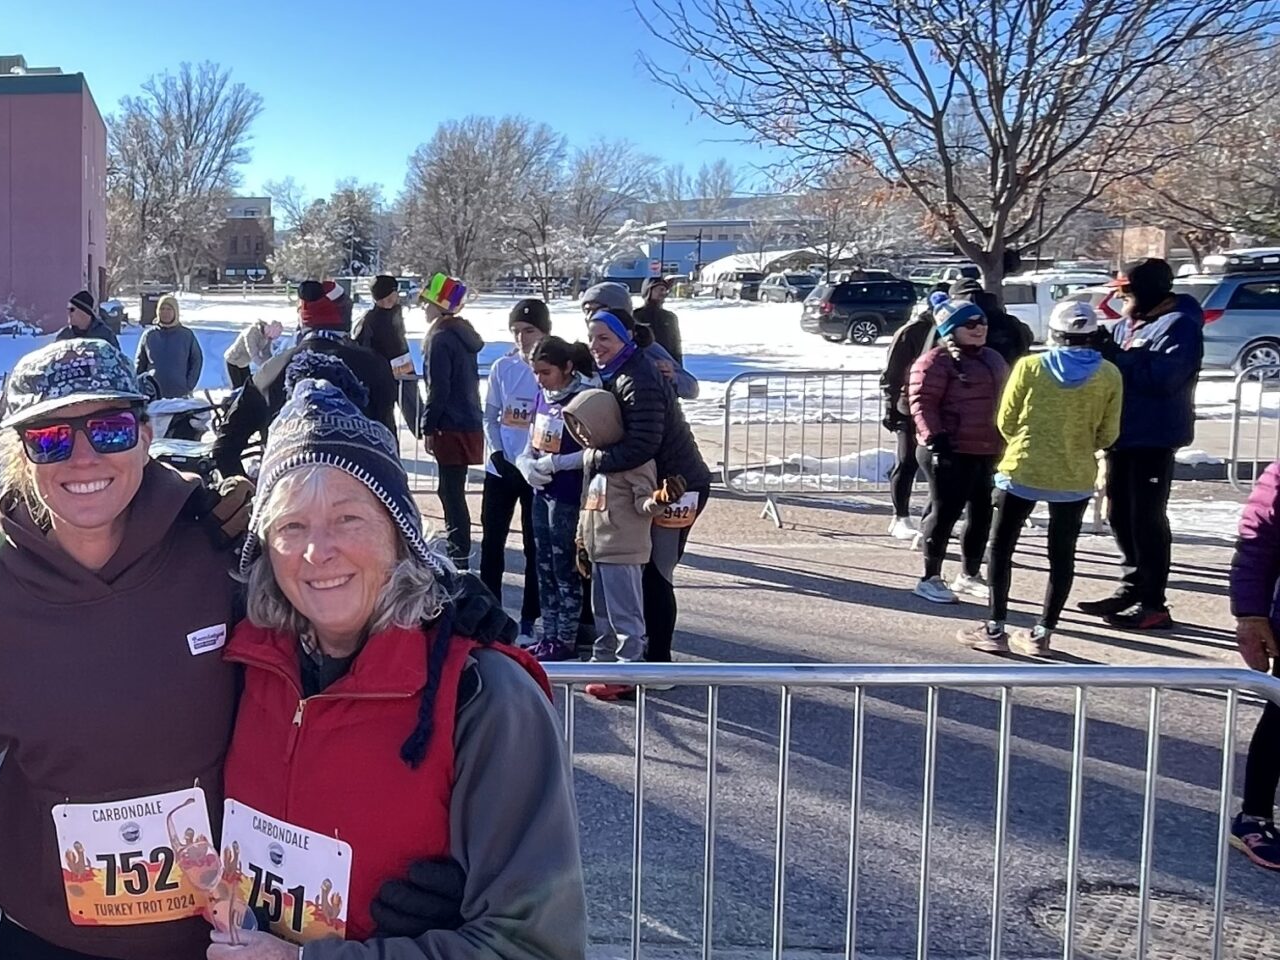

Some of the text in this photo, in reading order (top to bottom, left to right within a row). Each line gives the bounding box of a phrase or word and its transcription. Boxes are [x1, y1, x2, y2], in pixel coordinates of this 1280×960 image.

[664, 505, 689, 519] 942
[92, 801, 163, 822] CARBONDALE
[252, 815, 310, 850] CARBONDALE
[95, 846, 180, 896] 752
[94, 893, 196, 917] TURKEY TROT 2024
[248, 862, 305, 933] 751
